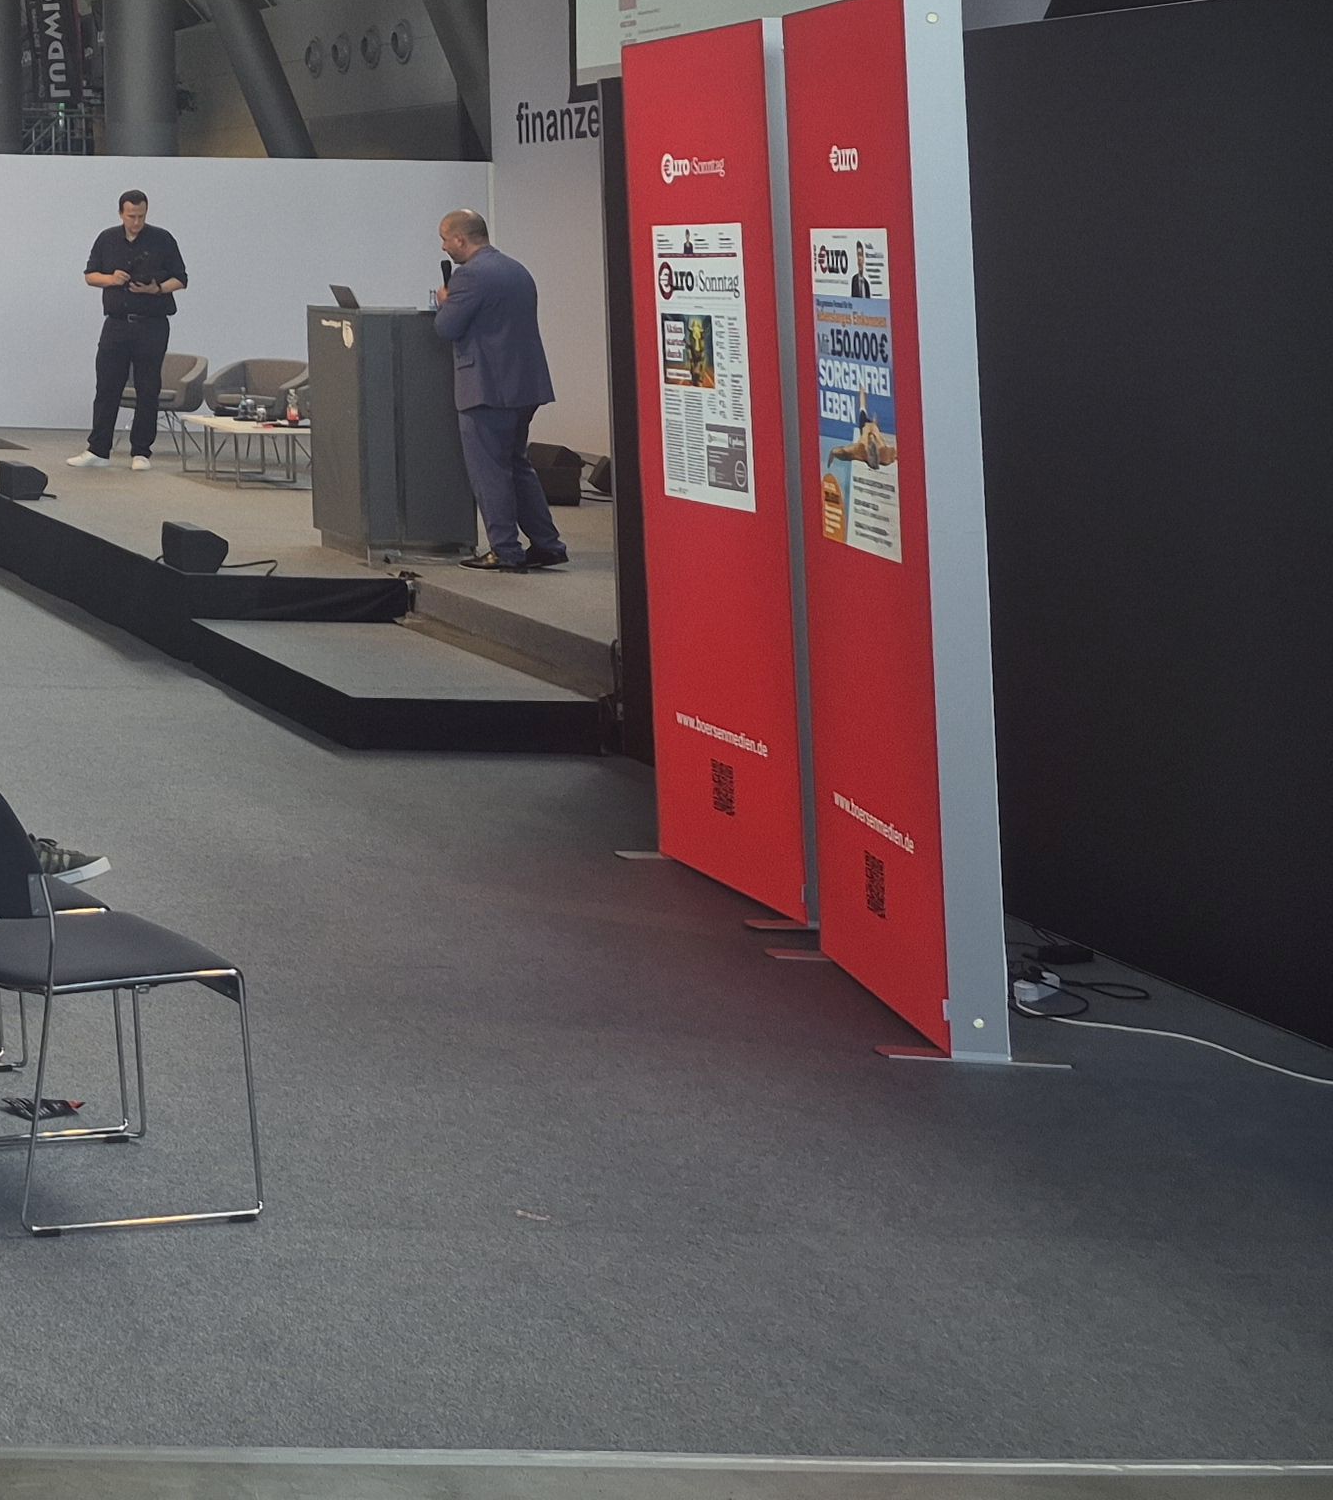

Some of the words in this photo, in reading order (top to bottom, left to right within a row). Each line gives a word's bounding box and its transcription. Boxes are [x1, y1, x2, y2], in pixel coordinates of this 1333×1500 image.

[698, 270, 740, 298] Sonntag
[830, 328, 888, 363] 150.000€
[819, 358, 891, 397] SORGENFREI
[820, 389, 856, 424] LEBEN
[676, 710, 768, 758] www.boersenmedien.de
[833, 791, 914, 854] www.boersenmedien.de
